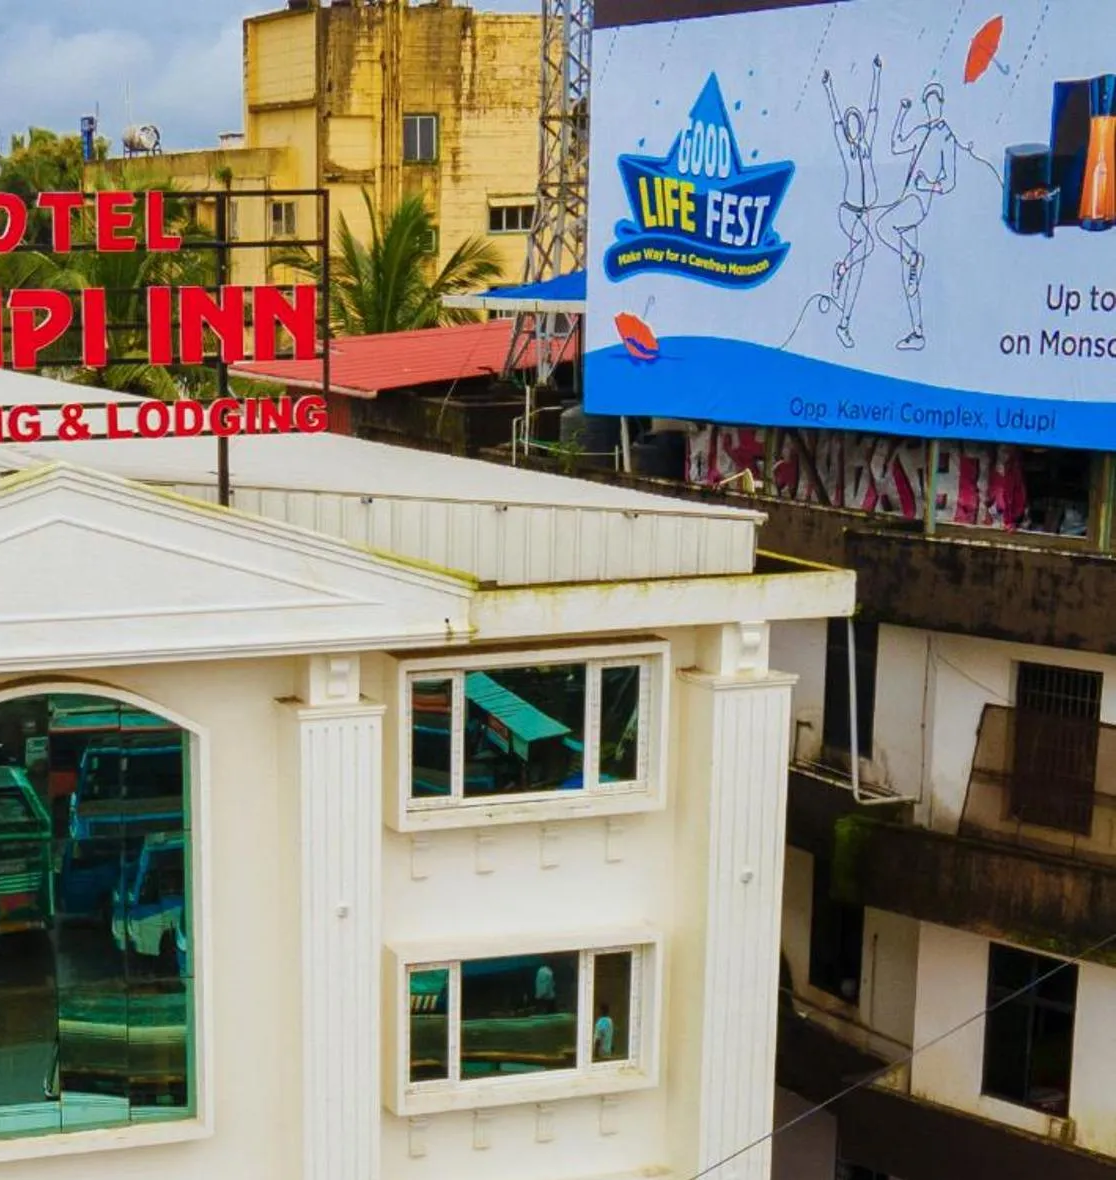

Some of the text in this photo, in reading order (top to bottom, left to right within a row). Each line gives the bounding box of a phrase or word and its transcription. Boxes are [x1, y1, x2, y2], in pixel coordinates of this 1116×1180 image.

[678, 120, 731, 178] GOOD
[638, 177, 771, 247] LIFE FEST
[643, 248, 664, 261] Way
[666, 249, 679, 261] for
[1047, 284, 1116, 317] Up to
[147, 285, 317, 365] INN
[1000, 333, 1031, 355] on
[57, 404, 92, 440] &
[106, 394, 327, 440] LODGING
[837, 399, 893, 421] Kaveri
[995, 408, 1057, 432] Udupi
